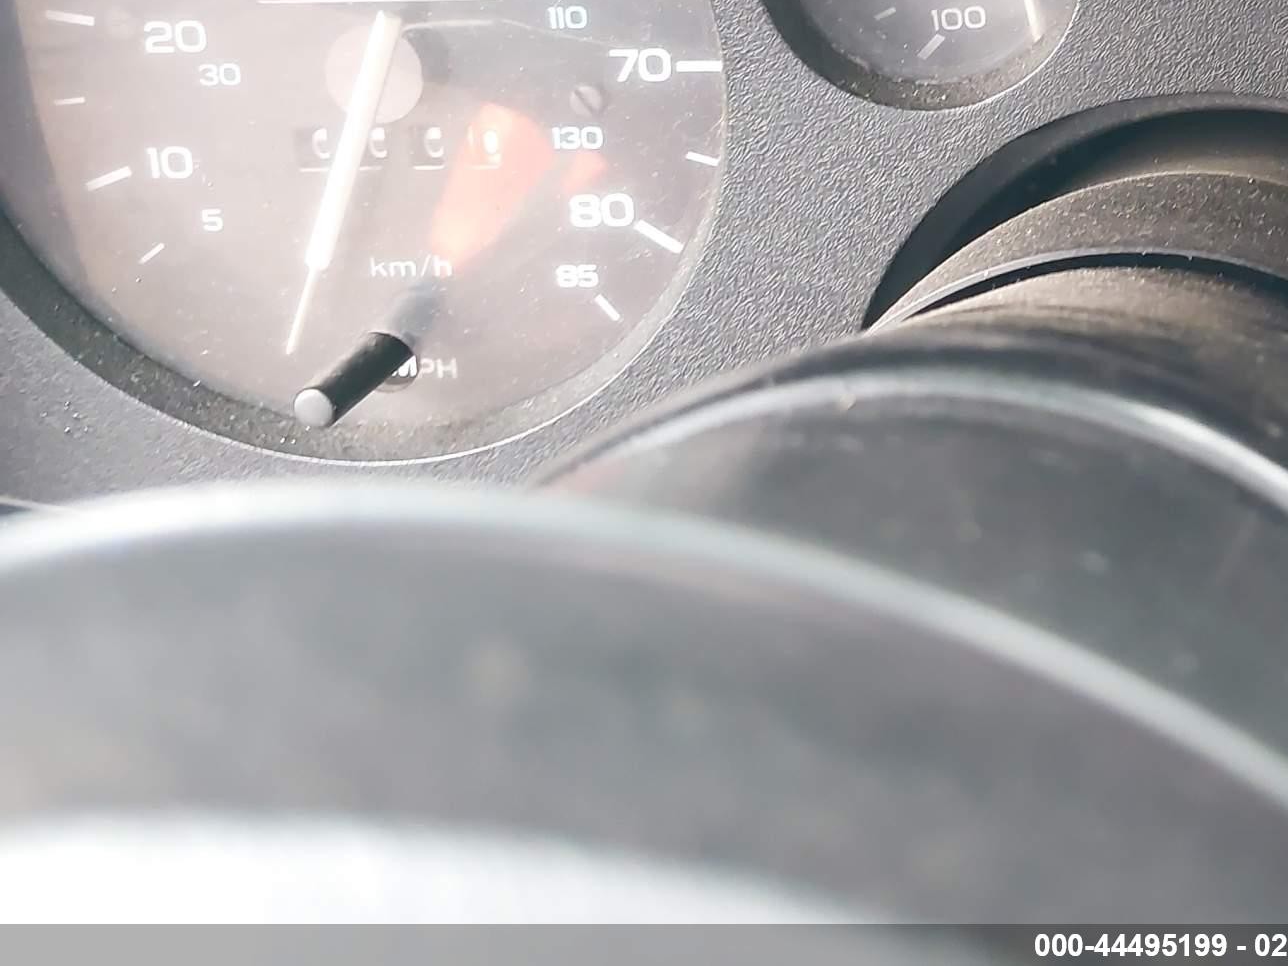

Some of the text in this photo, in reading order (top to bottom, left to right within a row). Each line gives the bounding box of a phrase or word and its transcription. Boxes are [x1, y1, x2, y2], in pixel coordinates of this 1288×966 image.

[547, 7, 587, 30] 110
[931, 5, 986, 30] 100
[143, 21, 206, 54] 20
[199, 63, 240, 86] 30
[608, 47, 672, 83] 70
[551, 126, 603, 150] 130
[146, 145, 193, 179] 10
[201, 208, 223, 232] 5
[568, 194, 635, 228] 80
[370, 254, 453, 277] km/h
[555, 265, 599, 288] 85
